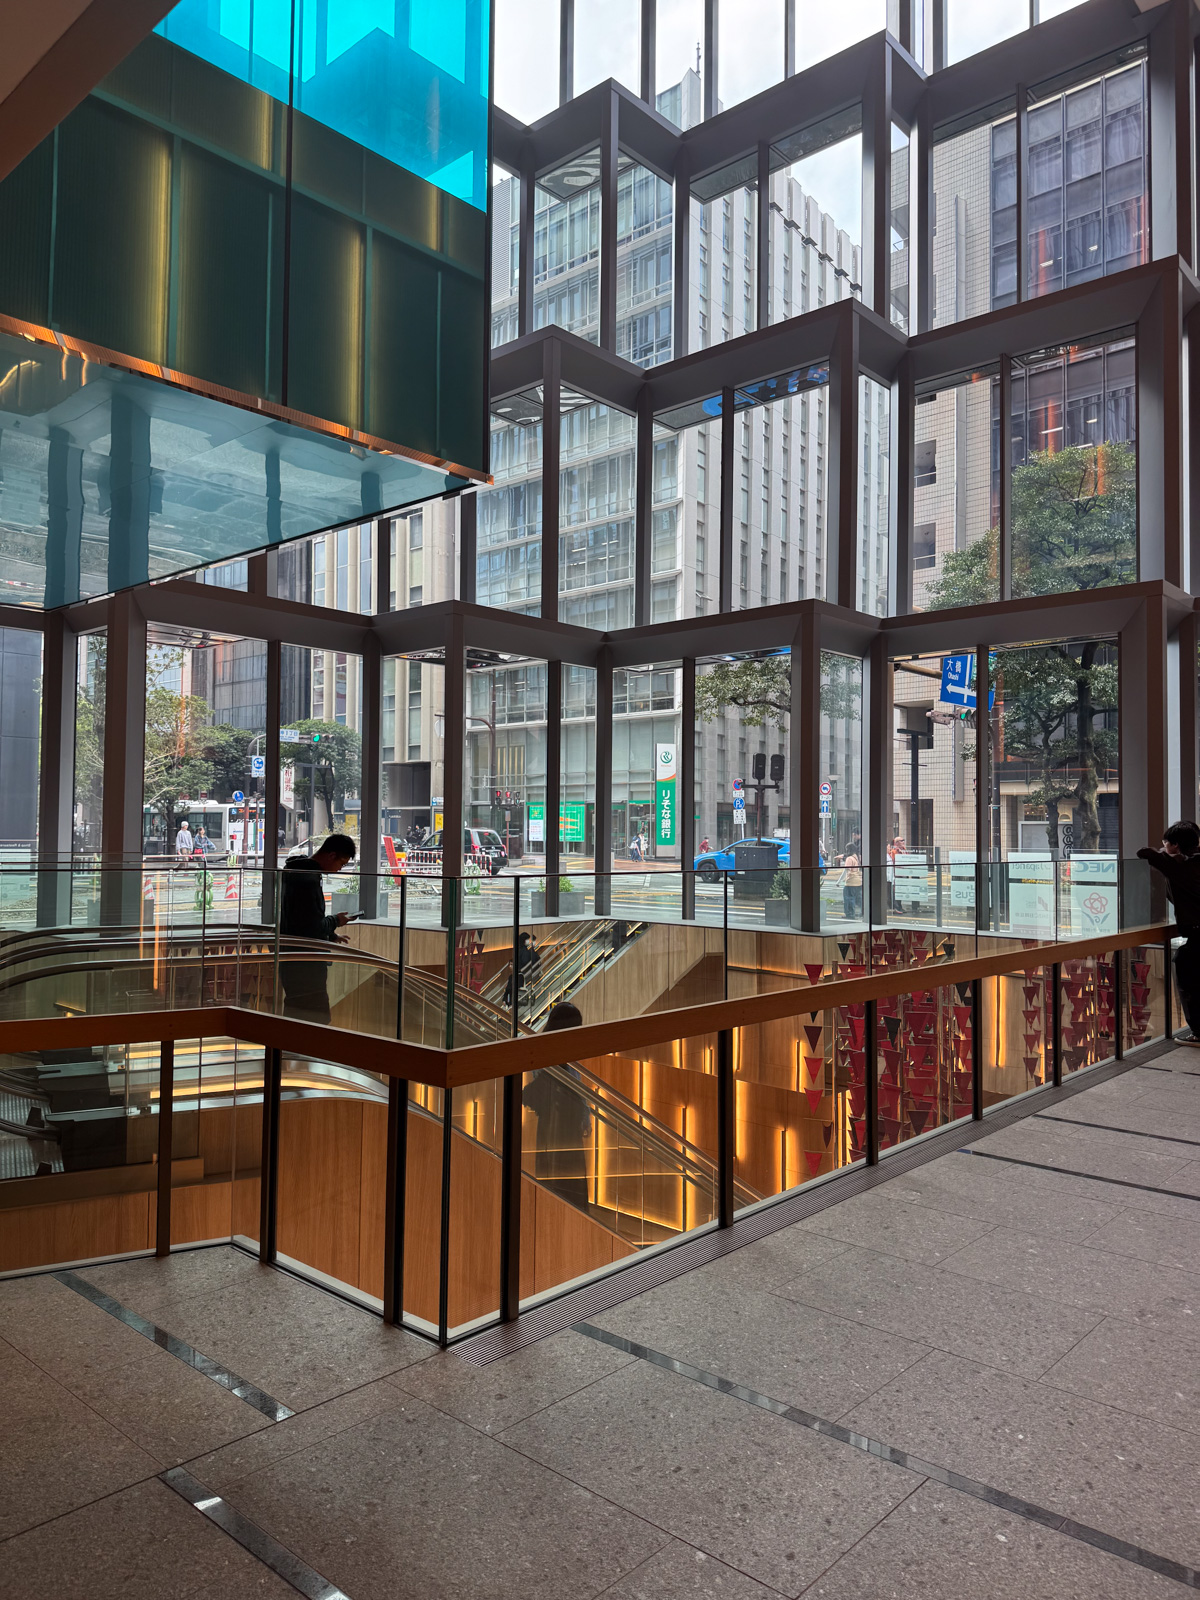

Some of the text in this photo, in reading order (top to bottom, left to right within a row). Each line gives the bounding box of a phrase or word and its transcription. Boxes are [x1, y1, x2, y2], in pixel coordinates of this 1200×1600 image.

[661, 789, 671, 839] りそな銀行
